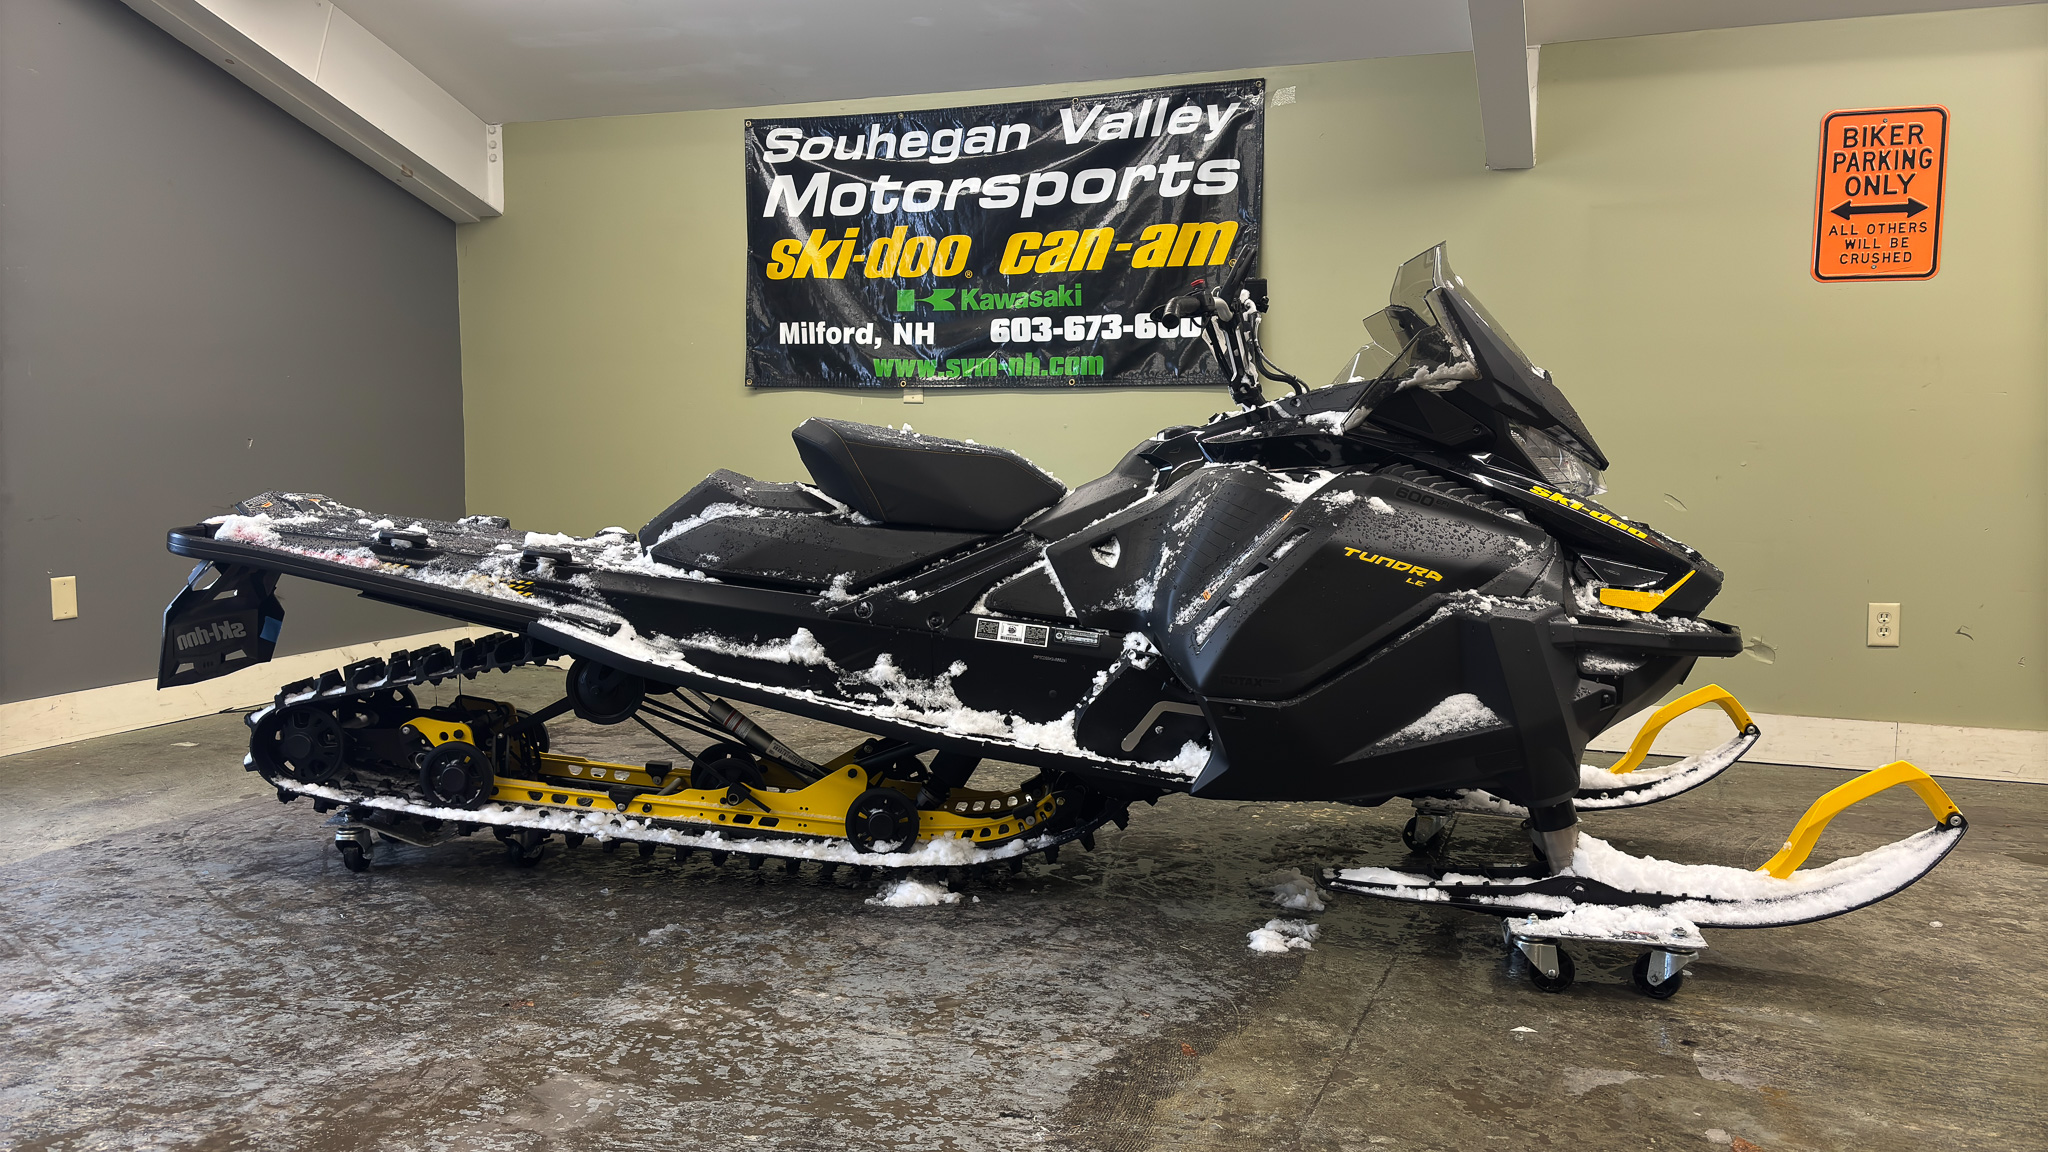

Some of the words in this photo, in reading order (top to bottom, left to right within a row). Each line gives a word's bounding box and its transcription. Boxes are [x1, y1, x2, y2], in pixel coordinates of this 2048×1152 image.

[763, 122, 1030, 165] Souhegan
[1059, 97, 1243, 145] Valley
[1843, 124, 1924, 148] BIKER
[1832, 148, 1933, 173] PARKING
[763, 155, 1241, 218] Motorsports
[1845, 173, 1916, 196] ONLY
[1829, 224, 1859, 236] ALL
[1867, 221, 1928, 235] OTHERS
[766, 226, 972, 280] ski-doo
[1000, 221, 1239, 275] can-am
[1845, 238, 1881, 250] WILL
[1890, 236, 1909, 248] BE
[1839, 251, 1912, 264] CRUSHED
[962, 283, 1082, 312] Kawasaki
[779, 321, 882, 350] Milford,
[893, 322, 935, 346] NH
[873, 352, 1105, 378] www.svm-nh.com
[1395, 486, 1434, 507] 600
[1530, 486, 1649, 540] ski-doo
[1344, 547, 1444, 582] TUNDRA
[1406, 577, 1427, 588] LE
